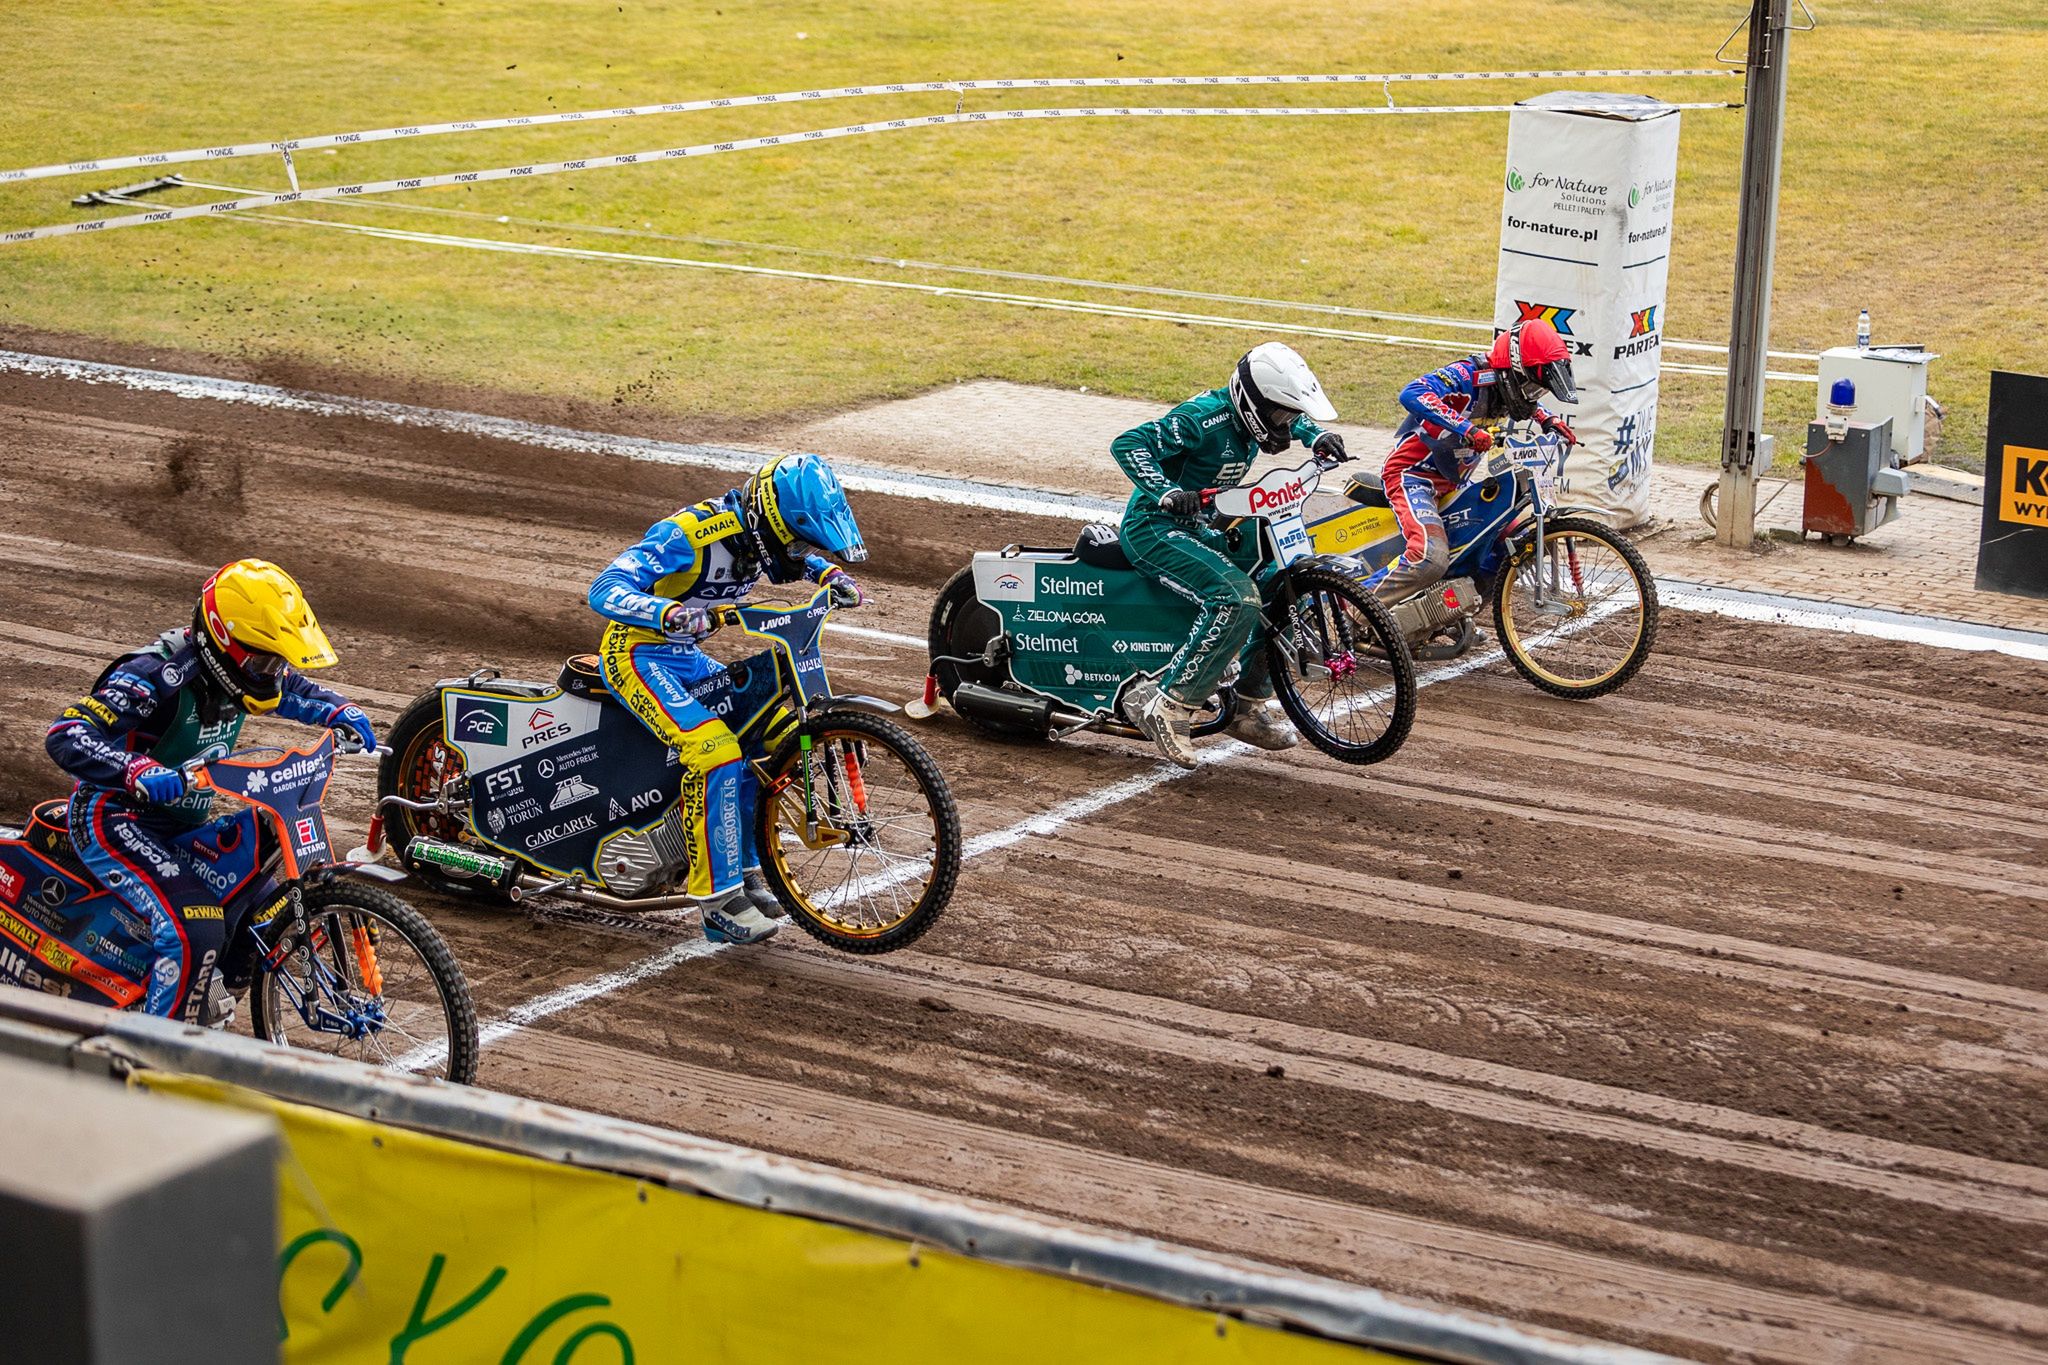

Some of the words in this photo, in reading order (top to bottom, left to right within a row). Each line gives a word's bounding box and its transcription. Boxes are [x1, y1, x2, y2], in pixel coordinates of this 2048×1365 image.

[1529, 172, 1554, 189] for
[1555, 176, 1608, 195] Nature
[1554, 202, 1576, 212] PELLET
[1581, 206, 1605, 216] PALETY
[1561, 192, 1606, 206] Solutions
[1507, 216, 1598, 242] for-nature.pl
[1628, 224, 1668, 243] for-nature.pl
[1613, 334, 1661, 359] PARTEX
[1202, 412, 1230, 429] CANAL+
[1492, 459, 1508, 471] TORU
[2015, 457, 2048, 498] K
[1248, 477, 1307, 514] Pentel
[695, 518, 736, 540] CANAL+
[1278, 531, 1306, 547] ARPOL
[752, 531, 773, 566] PRES
[643, 551, 664, 574] AVO
[1000, 581, 1018, 590] PGE
[1041, 576, 1105, 596] Stelmet
[813, 606, 827, 617] PRES
[1027, 610, 1072, 624] ZIELONA
[1073, 610, 1106, 625] GÓRA
[1288, 604, 1305, 649] GARCAREK
[1016, 633, 1078, 653] Stelmet
[1130, 642, 1150, 652] KING
[1152, 642, 1174, 652] TONY
[204, 647, 243, 695] cellfast
[716, 674, 732, 690] A/S
[1084, 673, 1121, 682] BETKOM
[467, 721, 495, 734] PGE
[522, 722, 571, 749] PRES
[556, 744, 596, 763] Mercedes-Benz
[559, 760, 575, 771] AUTO
[576, 751, 600, 767] FRELIK
[270, 753, 326, 784] cellfast
[807, 750, 815, 784] CLEAN
[273, 782, 296, 794] GARDEN
[485, 764, 523, 795] FST
[724, 777, 736, 798] A/S
[505, 798, 536, 815] MIASTO
[631, 788, 663, 812] AVO
[696, 782, 704, 817] DOMY
[507, 802, 543, 826] TORUŃ
[525, 813, 597, 848] GARCAREK
[682, 784, 698, 868] EXPOBUD
[724, 800, 740, 865] TRASBORG
[296, 842, 326, 857] BETARD
[426, 846, 480, 873] TRASBORG
[191, 858, 228, 890] FRIGO
[22, 903, 40, 920] AUTO
[184, 949, 217, 1026] BETARD
